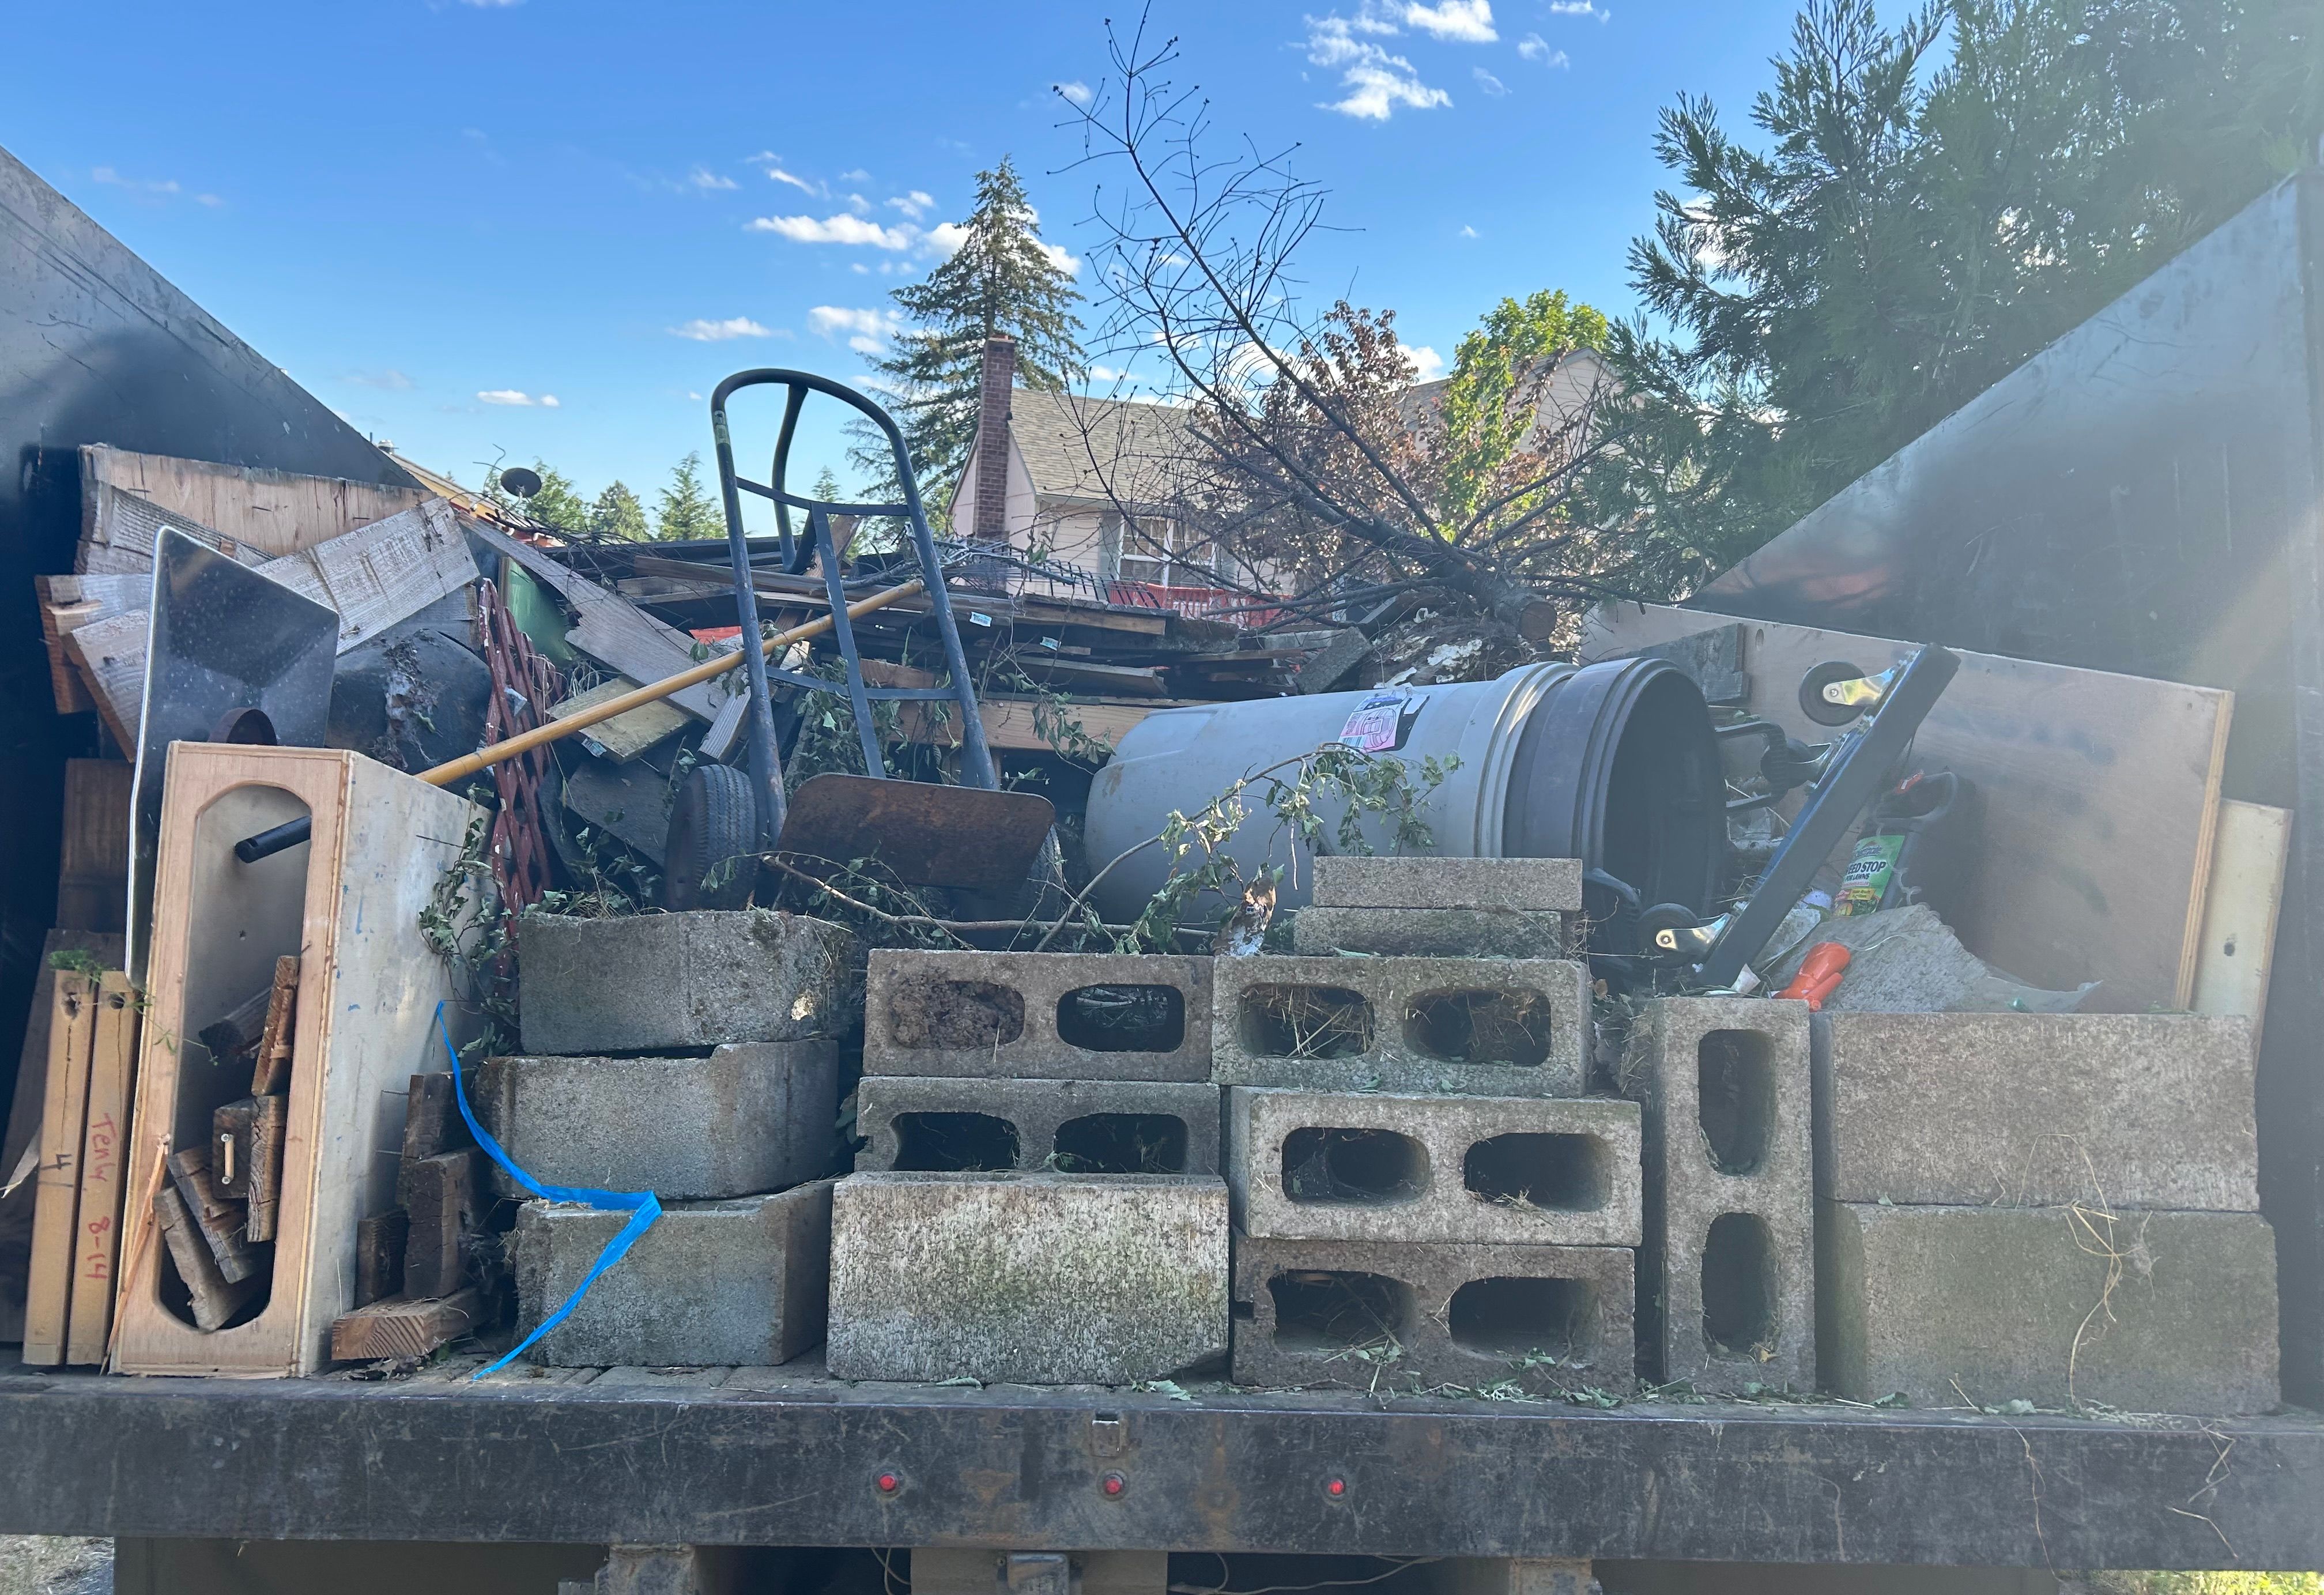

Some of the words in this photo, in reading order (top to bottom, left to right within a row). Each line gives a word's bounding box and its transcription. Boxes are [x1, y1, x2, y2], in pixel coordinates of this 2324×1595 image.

[1847, 862, 1862, 874] EED
[1860, 861, 1887, 872] STOP
[1852, 873, 1870, 881] LAWNS
[84, 1216, 111, 1279] 8-14
